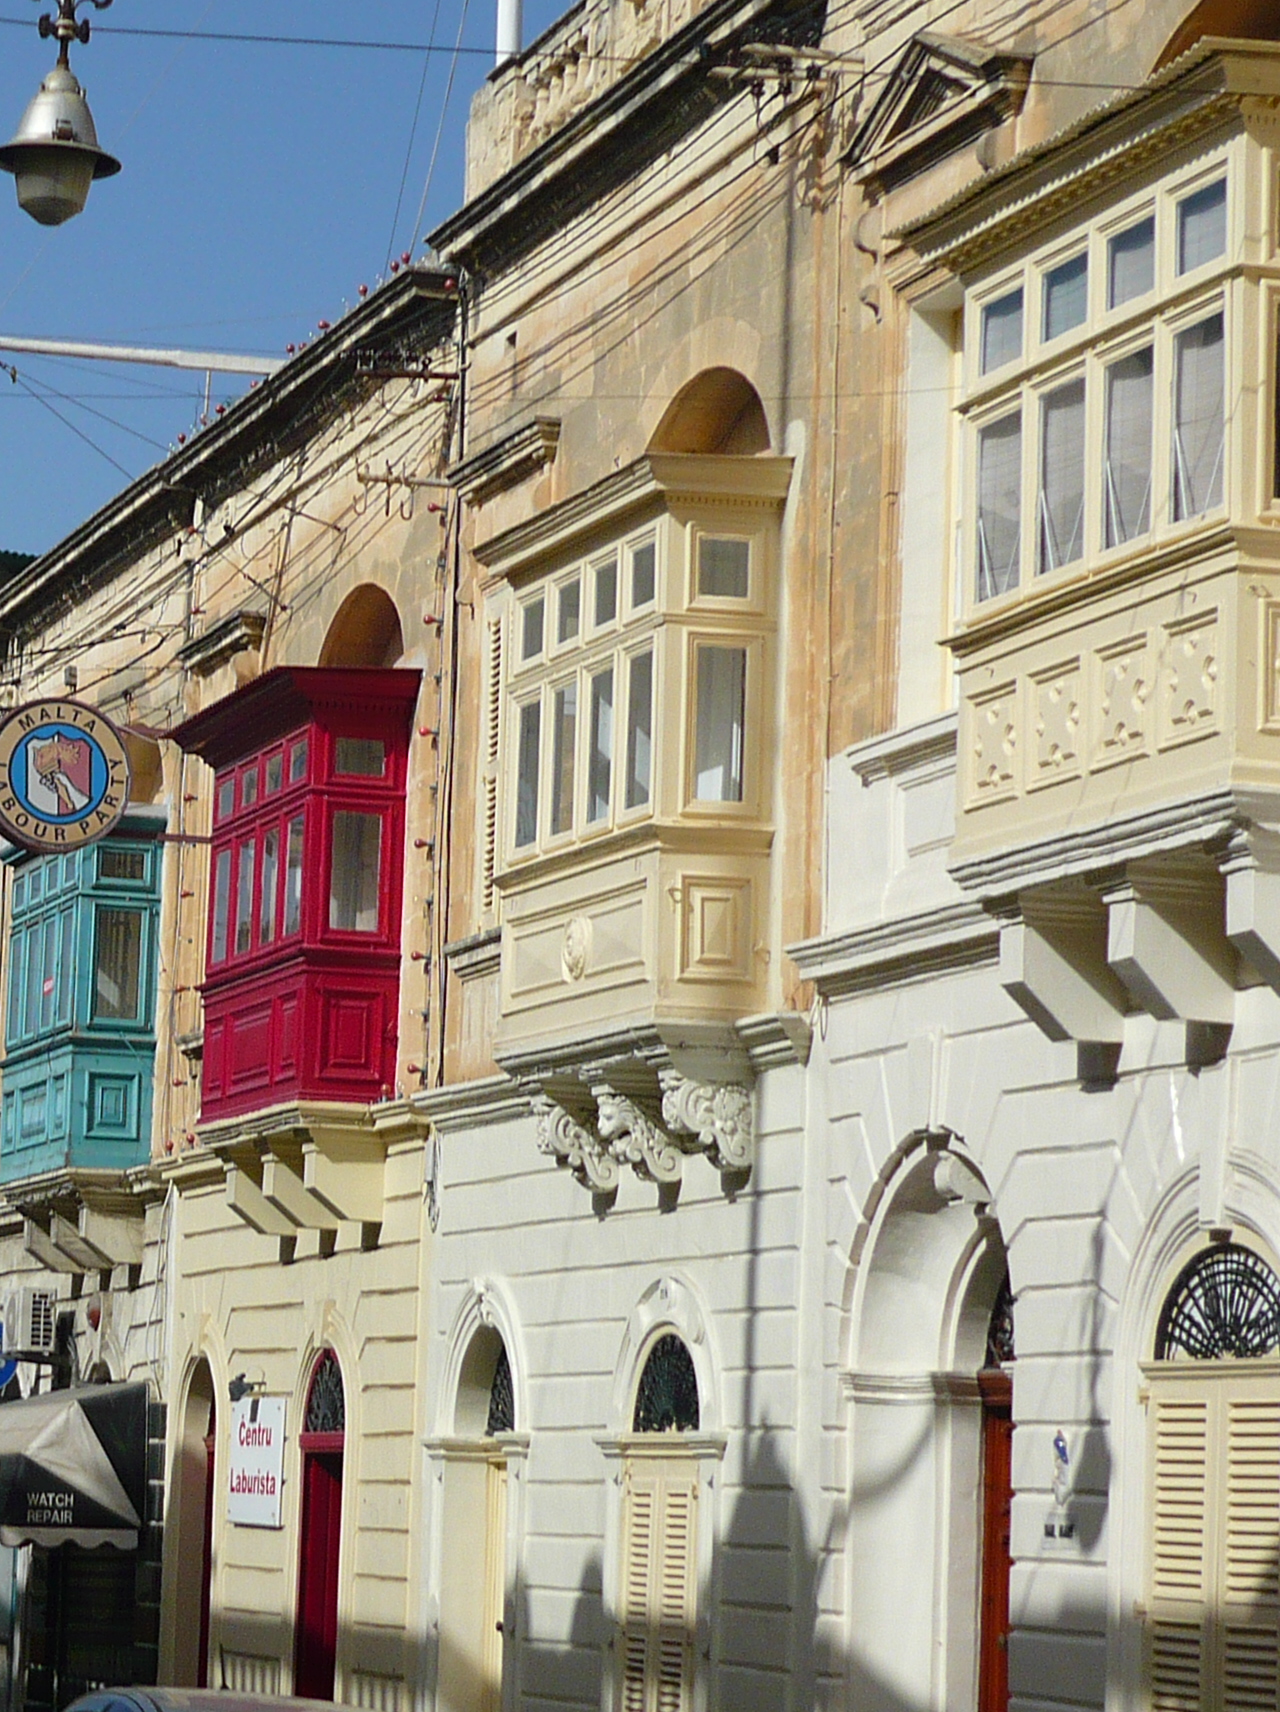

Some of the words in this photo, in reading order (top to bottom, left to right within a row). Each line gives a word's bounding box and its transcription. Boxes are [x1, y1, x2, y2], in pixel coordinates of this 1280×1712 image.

[18, 705, 97, 732] MALTA
[79, 758, 124, 836] PARTY
[229, 1468, 276, 1496] Laburista
[27, 1493, 75, 1506] WATCH
[28, 1511, 73, 1524] REPAIR
